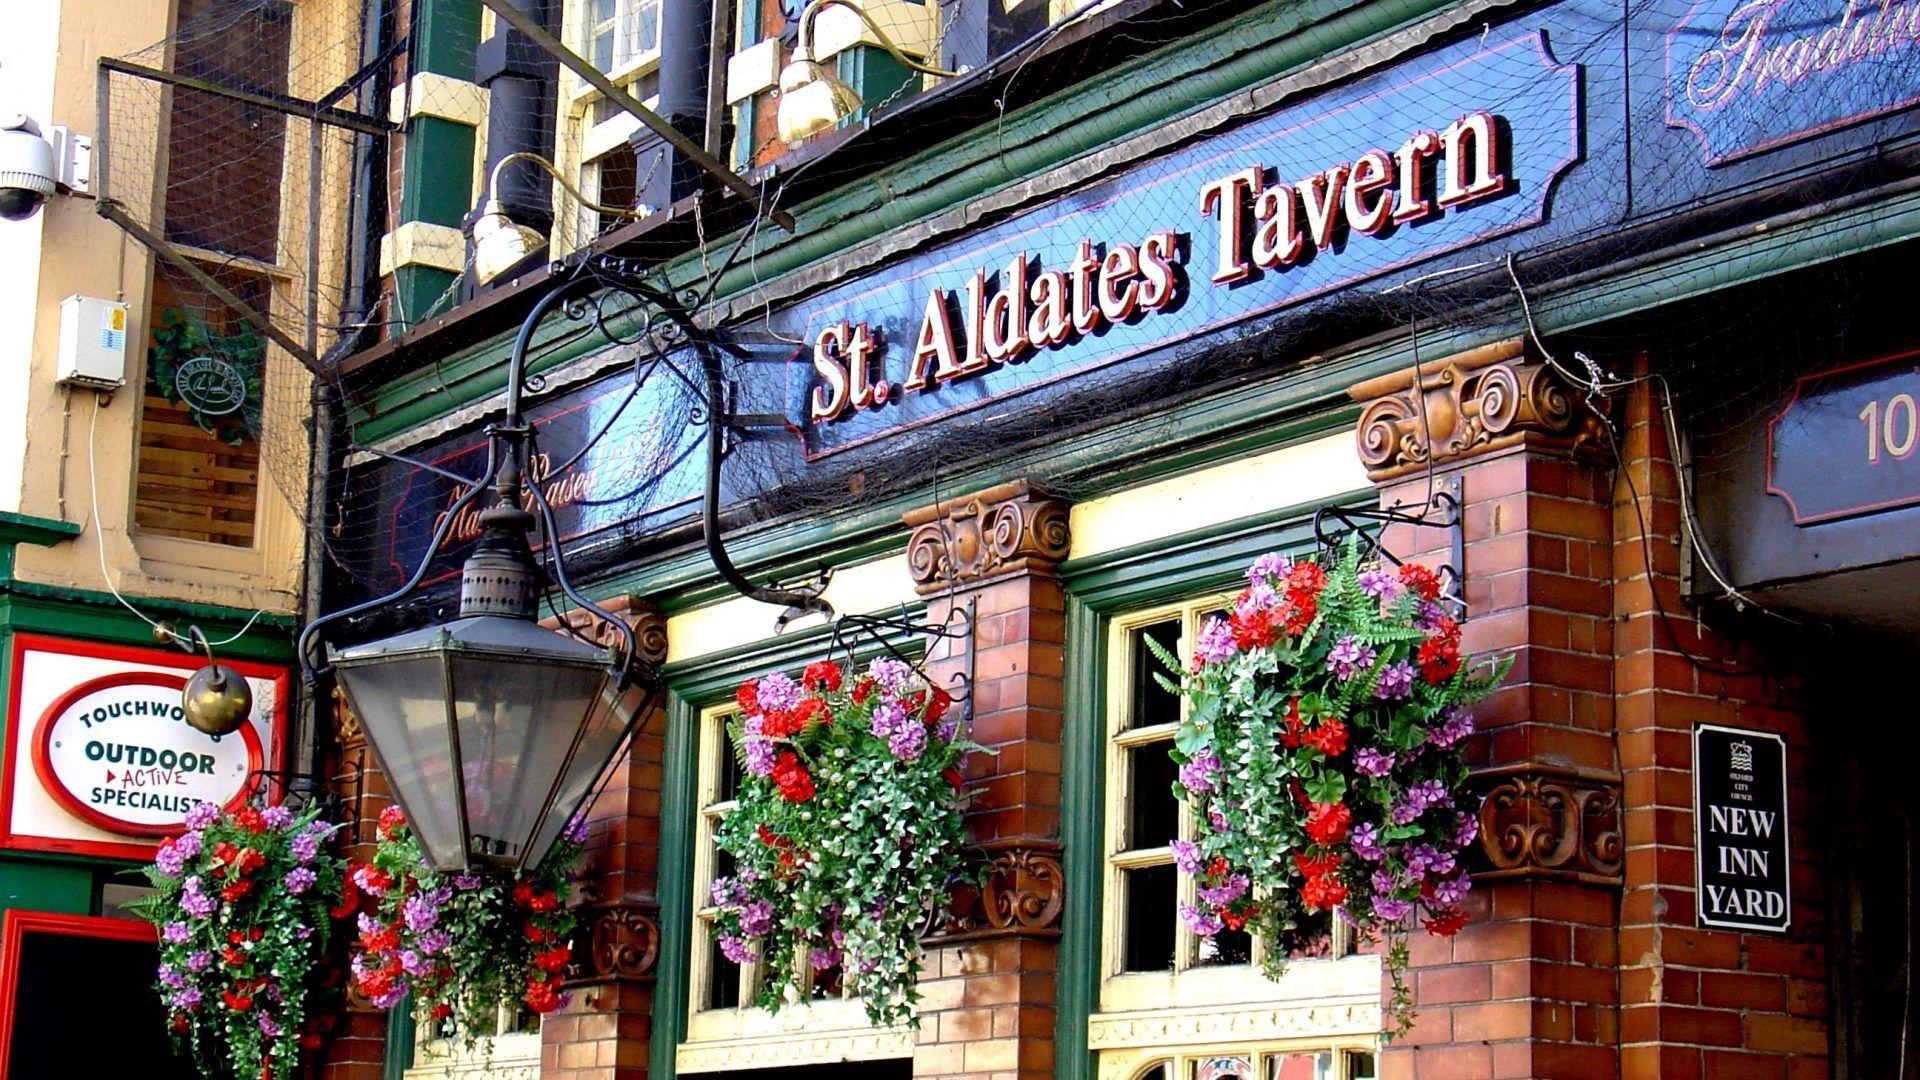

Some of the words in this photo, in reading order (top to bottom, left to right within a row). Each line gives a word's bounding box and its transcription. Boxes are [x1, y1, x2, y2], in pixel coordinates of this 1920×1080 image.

[811, 319, 888, 422] St.
[904, 228, 1180, 394] Aldates
[1199, 110, 1506, 286] Tavern
[1859, 393, 1918, 462] 10
[85, 740, 215, 775] OUTDOOR
[1709, 804, 1776, 838] NEW
[1718, 845, 1769, 878] INN
[1705, 884, 1785, 919] YARD
